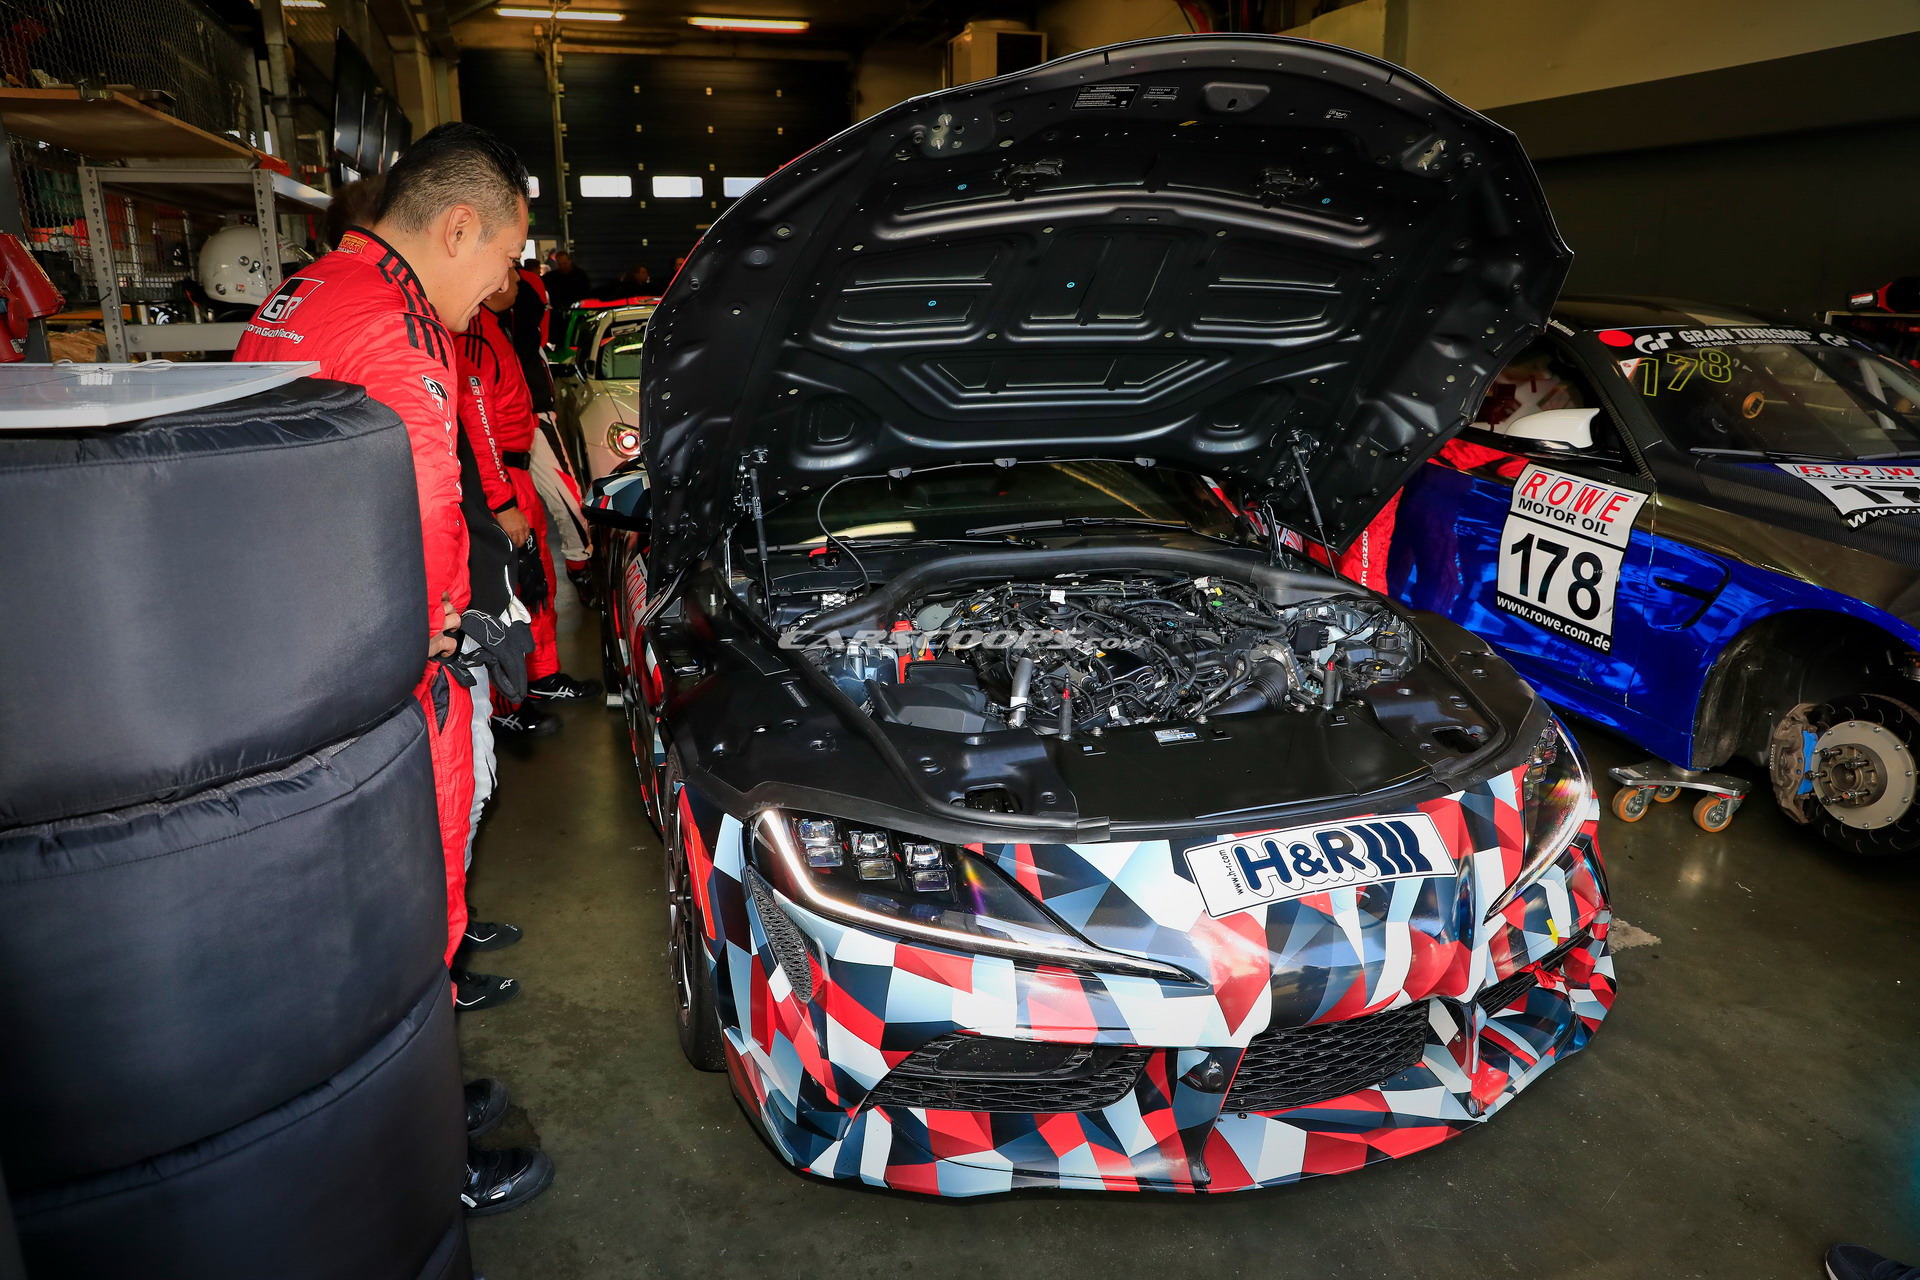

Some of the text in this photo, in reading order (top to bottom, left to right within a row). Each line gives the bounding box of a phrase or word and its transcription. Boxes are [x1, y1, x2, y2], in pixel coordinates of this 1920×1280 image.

[263, 295, 302, 320] GR
[1678, 328, 1808, 343] GRAN TURISMO
[1638, 347, 1732, 396] 178
[476, 397, 491, 436] TOYOTA
[1518, 470, 1633, 523] ROWE
[1518, 498, 1608, 536] MOTOR OIL
[1511, 533, 1603, 621] 178
[1497, 596, 1611, 651] www.rowe.com.de
[1219, 849, 1244, 896] www.h-r.com
[1233, 830, 1367, 891] H&R
